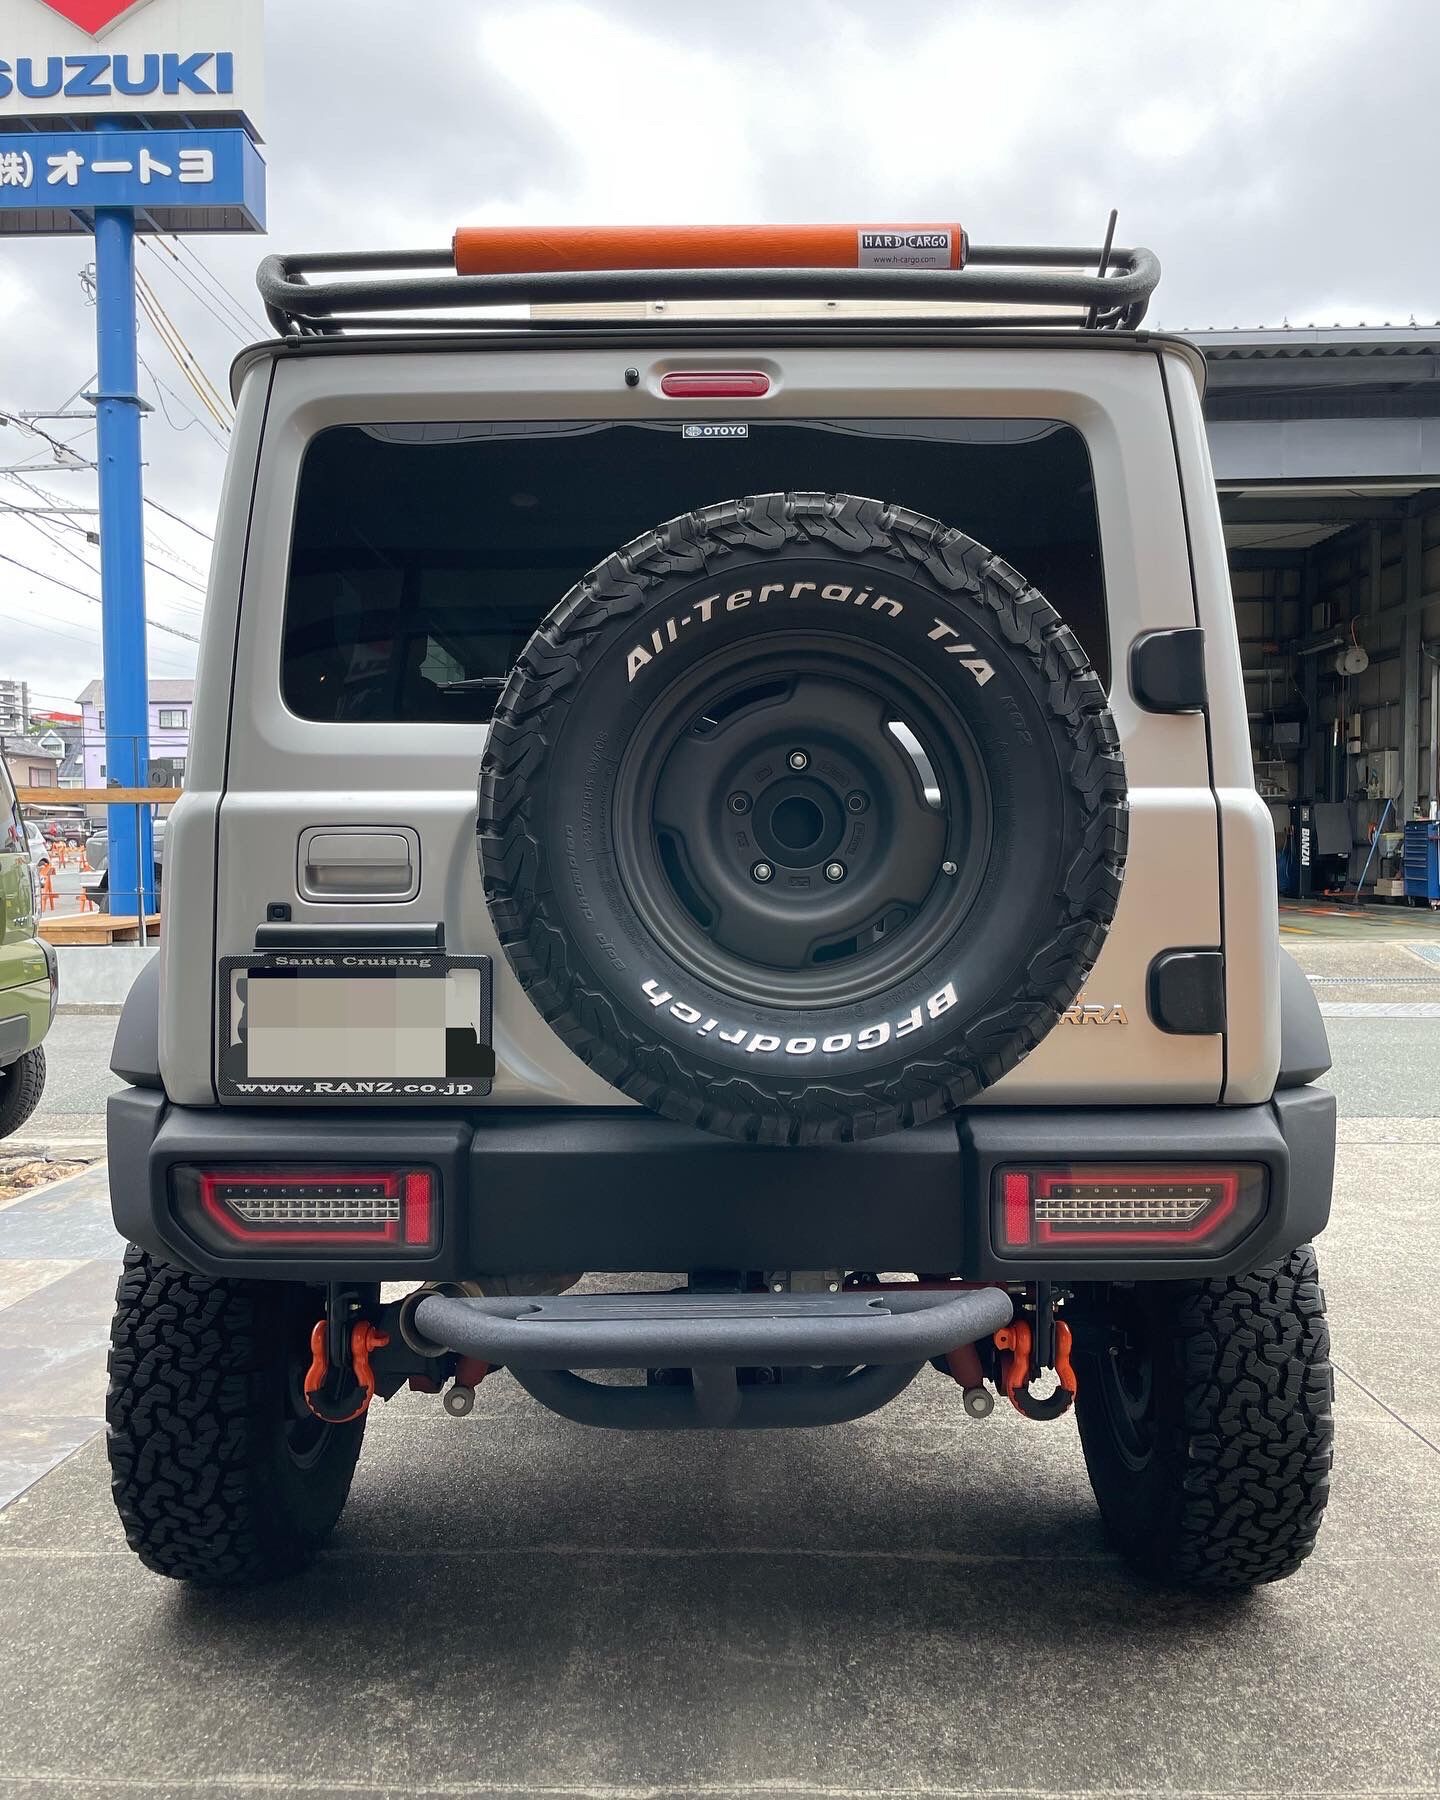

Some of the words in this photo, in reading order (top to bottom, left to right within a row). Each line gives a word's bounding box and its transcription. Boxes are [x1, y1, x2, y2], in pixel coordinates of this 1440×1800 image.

[0, 52, 233, 98] UZUKI
[864, 235, 902, 247] HARD
[908, 235, 947, 247] CARGO
[873, 256, 936, 265] www.h-cargo.com
[703, 427, 746, 436] OTOYO
[626, 581, 904, 683] All-Terrain
[927, 617, 997, 687] T/A
[1301, 827, 1310, 866] BANZAI
[275, 956, 336, 966] Santa
[343, 956, 431, 968] Cruising
[641, 980, 959, 1055] BFGoodrich
[236, 1082, 473, 1095] www.RANZ.co.jp
